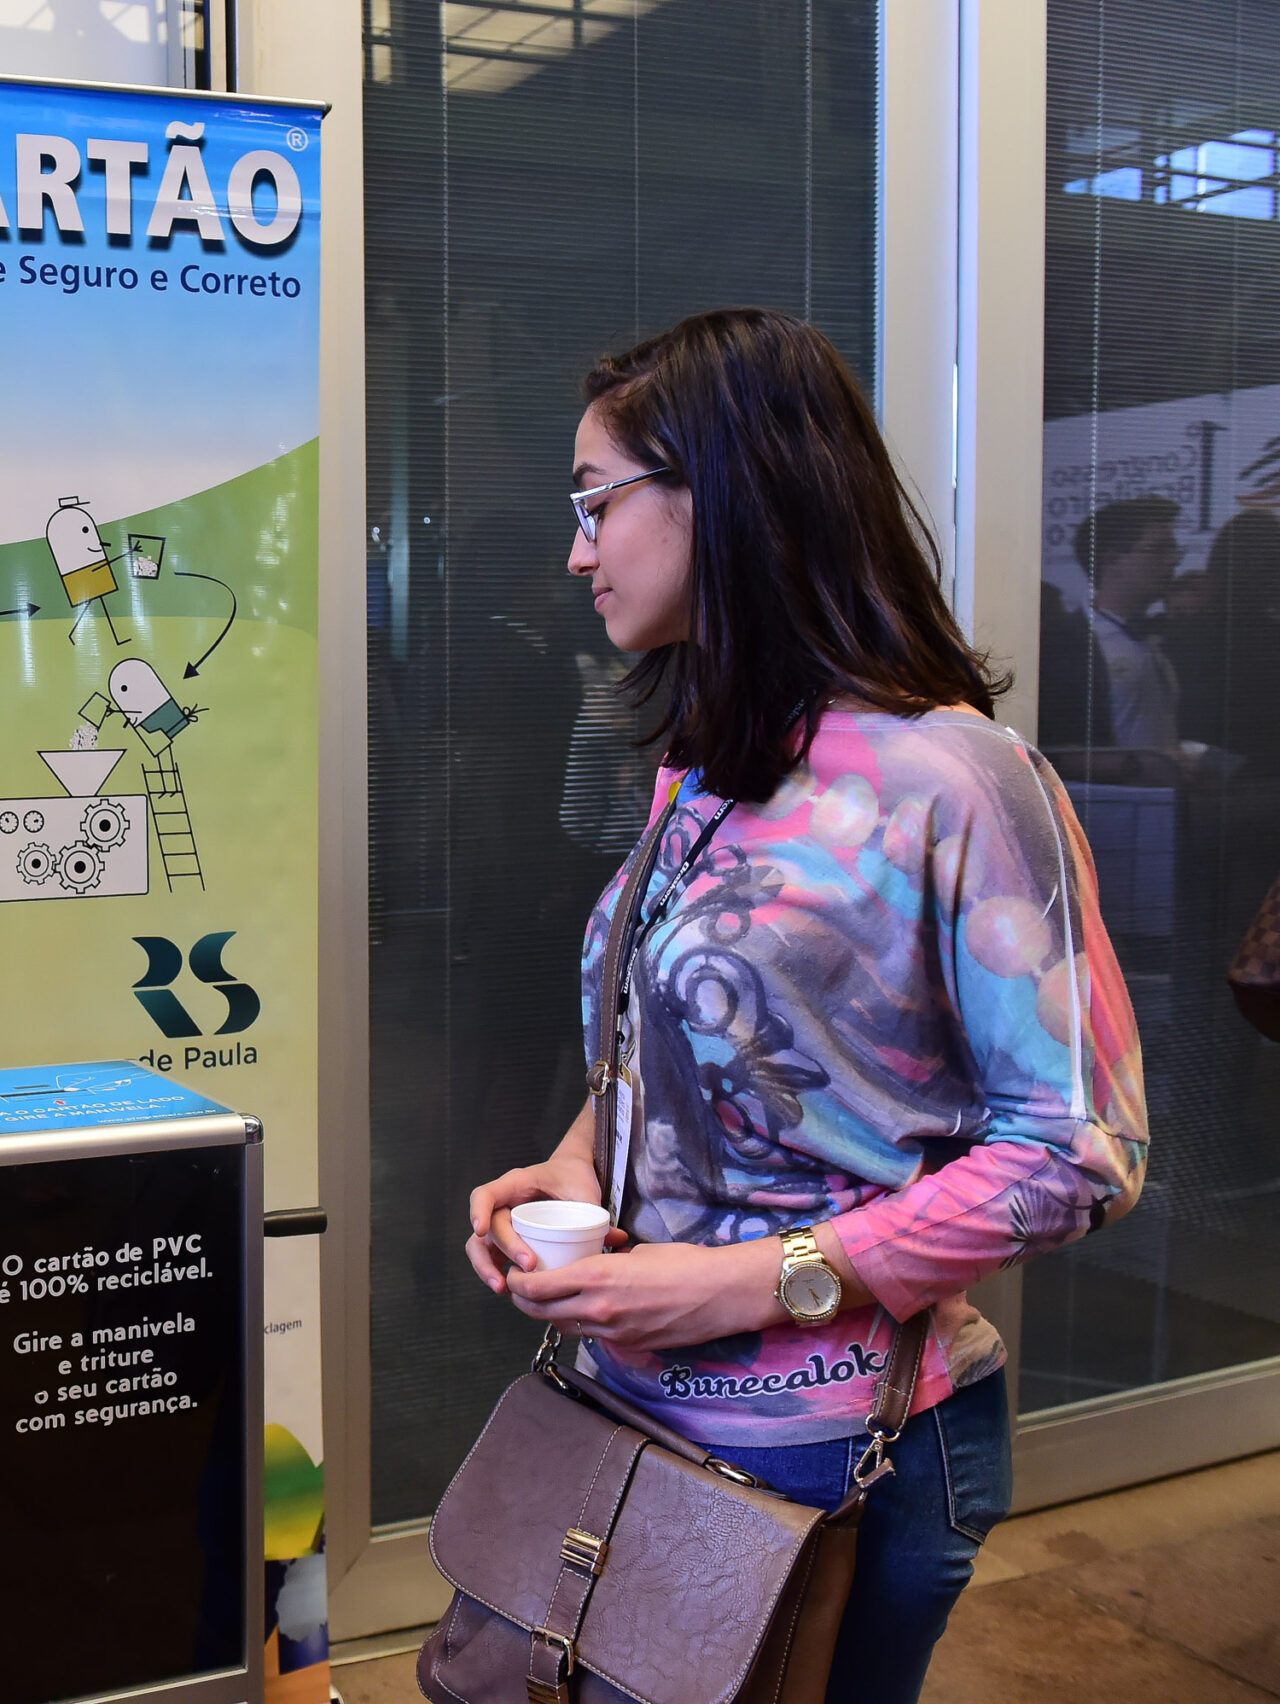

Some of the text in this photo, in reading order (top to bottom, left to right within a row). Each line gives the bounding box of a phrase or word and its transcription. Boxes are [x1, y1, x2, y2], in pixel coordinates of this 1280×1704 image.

[20, 255, 139, 294] Seguro
[150, 269, 168, 291] e
[180, 264, 301, 298] Correto
[659, 861, 690, 906] Braskem
[184, 1042, 258, 1070] Paula
[4, 1114, 50, 1122] GIRE
[137, 1096, 185, 1104] LADO
[2, 1233, 202, 1276] O cartão de PVC
[20, 1274, 89, 1301] 100%
[97, 1257, 213, 1291] reciclável.
[13, 1312, 196, 1354] Gire a manivela
[264, 1319, 302, 1335] clagem
[58, 1348, 154, 1375] e triture
[659, 1342, 889, 1399] Bunecalok
[34, 1367, 177, 1405] o seu cartão
[15, 1394, 198, 1433] com segurança.
